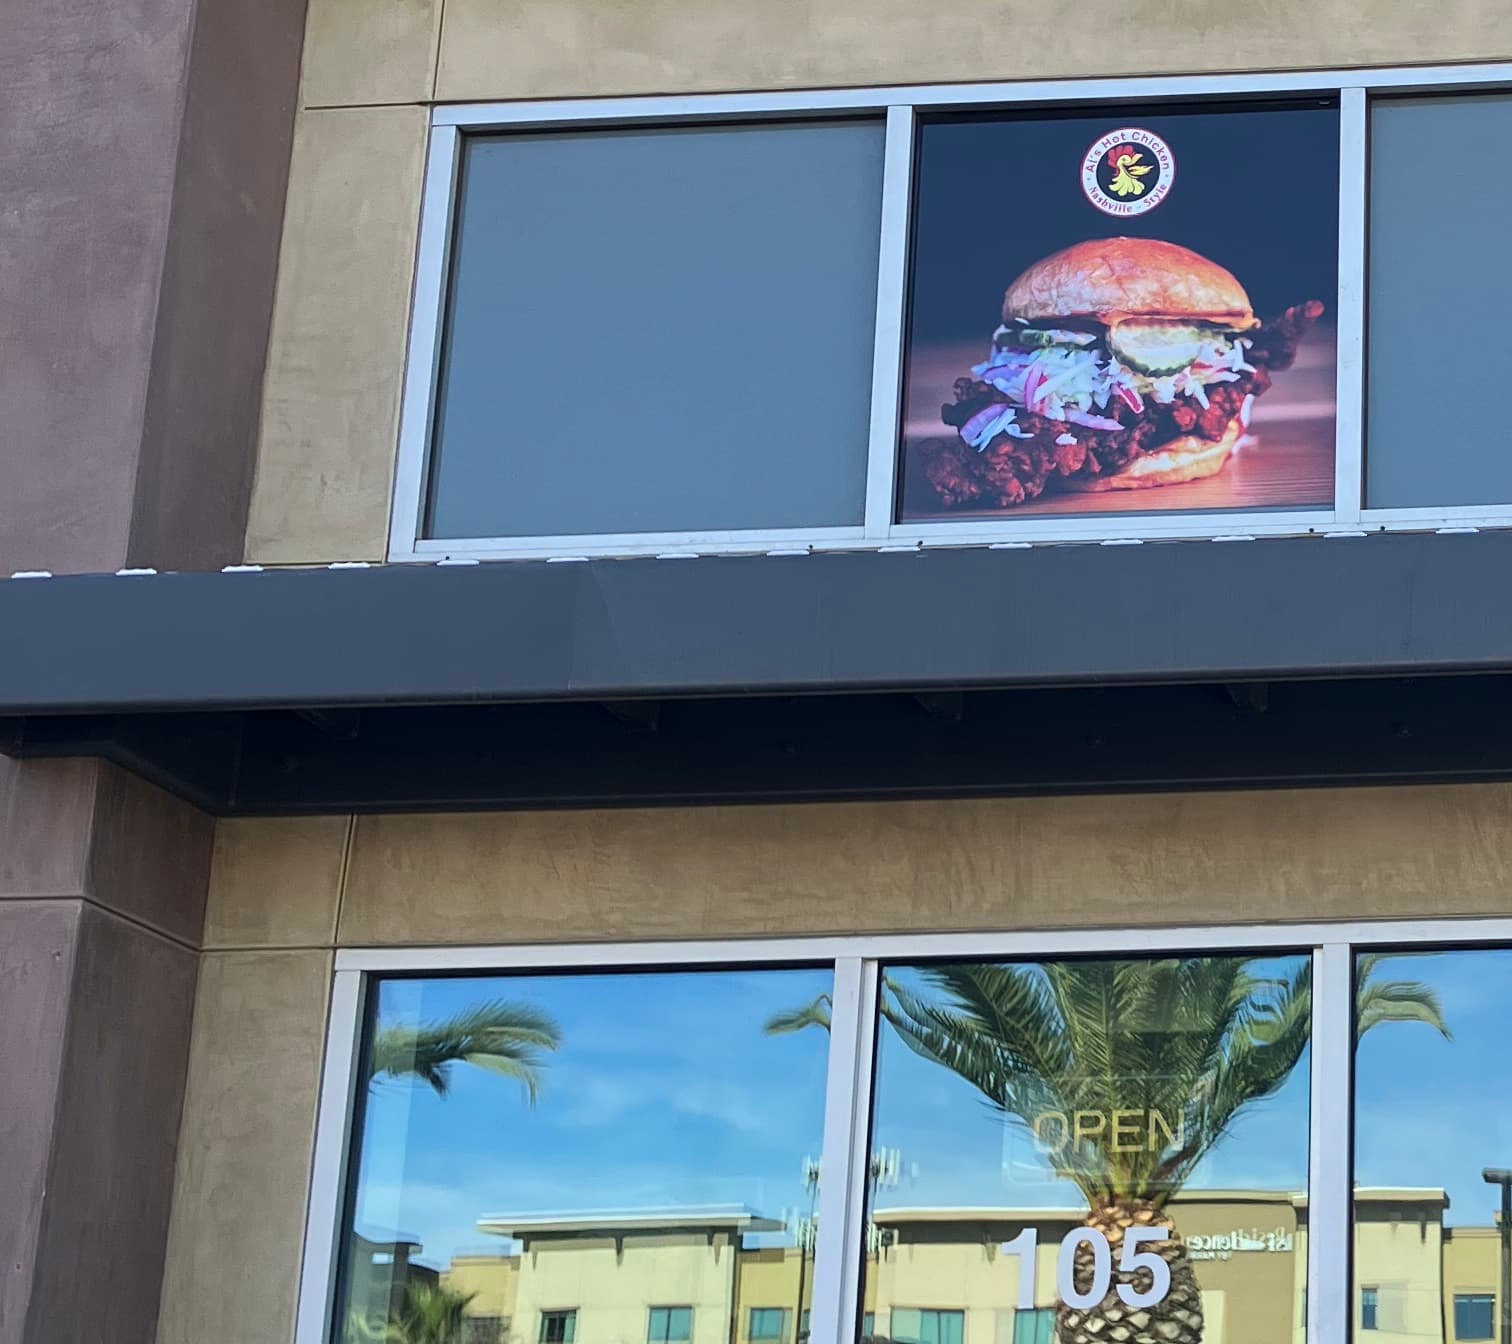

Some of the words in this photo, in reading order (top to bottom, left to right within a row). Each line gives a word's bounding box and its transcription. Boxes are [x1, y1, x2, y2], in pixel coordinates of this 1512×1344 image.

[1085, 149, 1102, 173] Al's
[1101, 131, 1126, 149] Hot
[1131, 131, 1170, 170] Chicken
[1088, 186, 1133, 213] Nashville
[1143, 184, 1168, 207] Style
[1033, 1108, 1185, 1154] OPEN
[1000, 1226, 1172, 1310] 105
